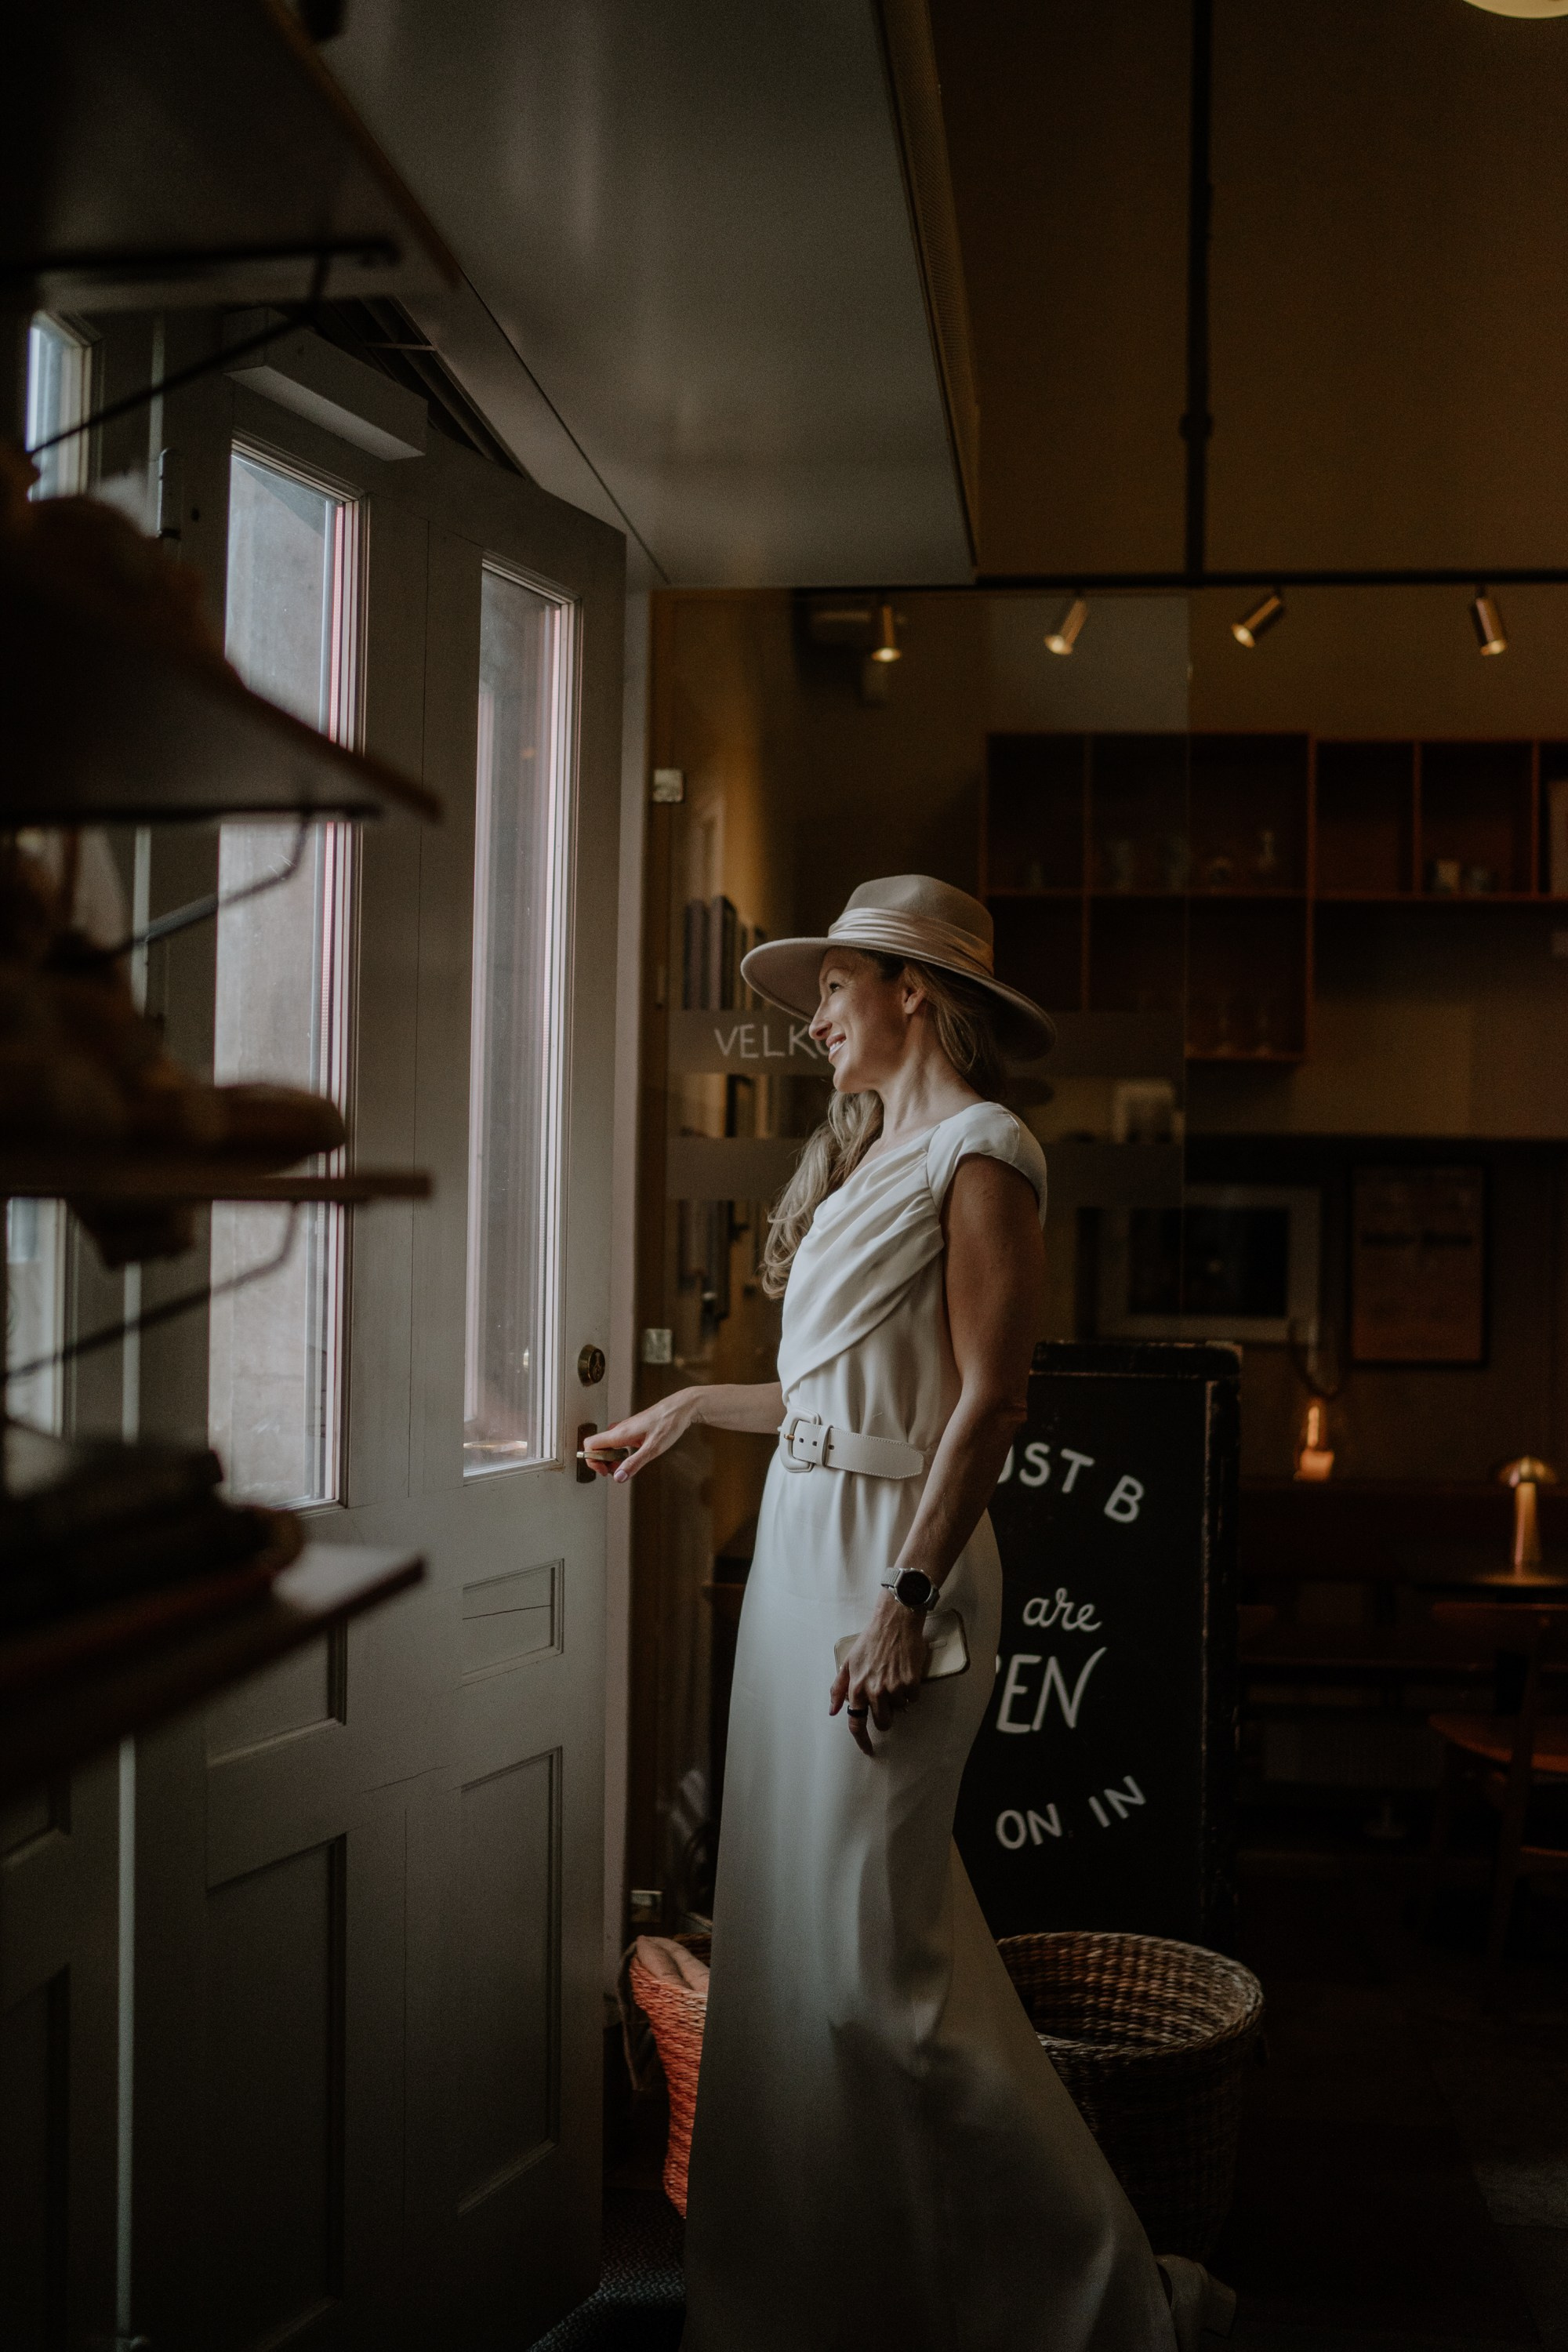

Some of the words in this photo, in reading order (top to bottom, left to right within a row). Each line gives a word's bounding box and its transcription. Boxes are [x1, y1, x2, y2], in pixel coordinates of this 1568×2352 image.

[713, 1021, 829, 1060] VELK
[1103, 1474, 1145, 1524] B
[1022, 1586, 1103, 1633] are
[994, 1646, 1109, 1734] EN
[995, 1802, 1062, 1850] ON
[1087, 1774, 1146, 1828] IN
